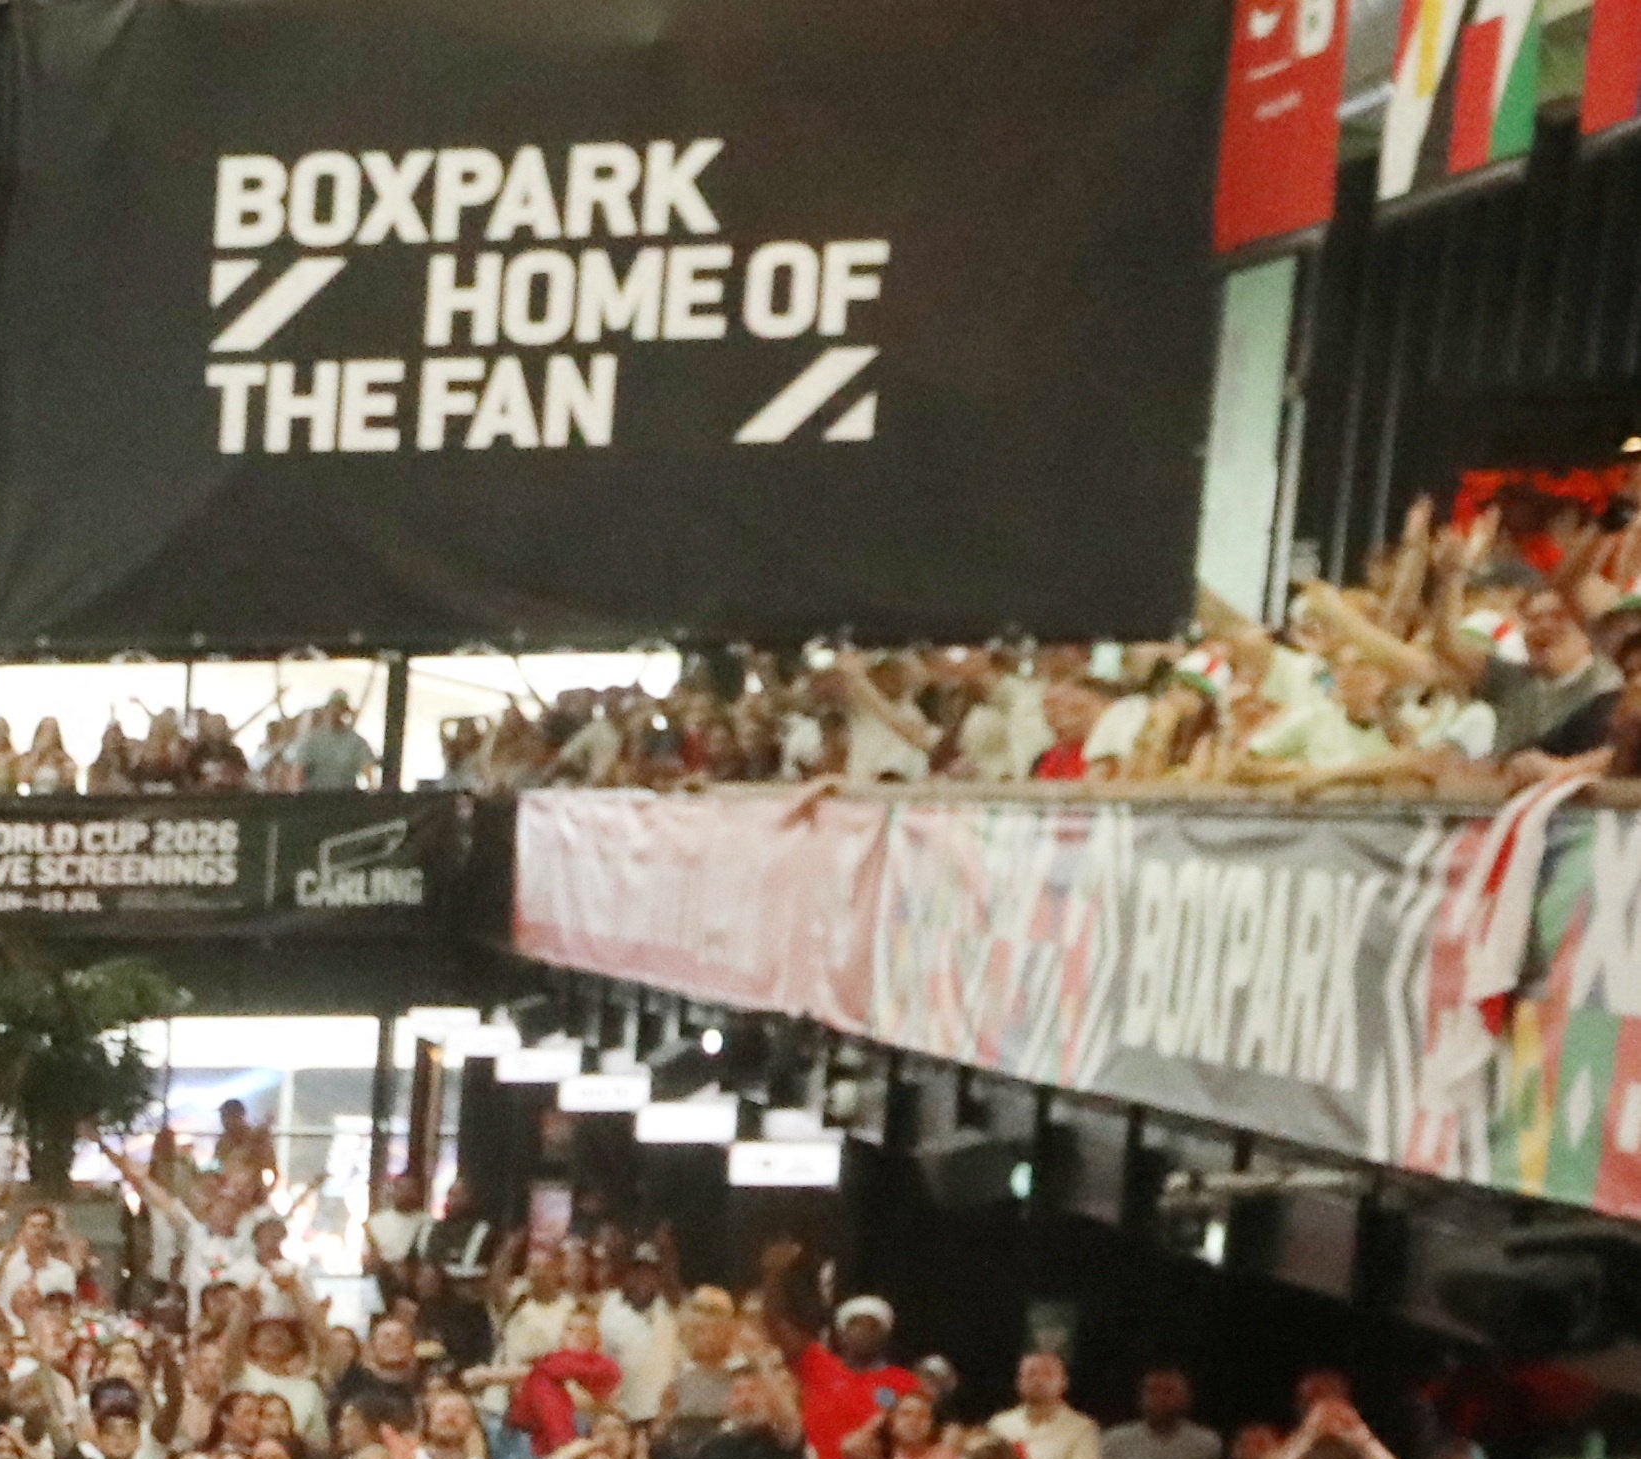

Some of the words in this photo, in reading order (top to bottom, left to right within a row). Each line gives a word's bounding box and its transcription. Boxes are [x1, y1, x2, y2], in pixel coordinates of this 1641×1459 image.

[212, 138, 725, 248] BOXPARK
[424, 244, 733, 347] HOME
[742, 239, 890, 342] OF
[205, 359, 405, 455] THE
[416, 353, 618, 449] FAN
[36, 855, 238, 886] SCREENINGS
[81, 821, 150, 853] CUP
[152, 820, 239, 852] 2026
[295, 869, 424, 906] CARLING
[1119, 857, 1385, 1092] BOXPARK
